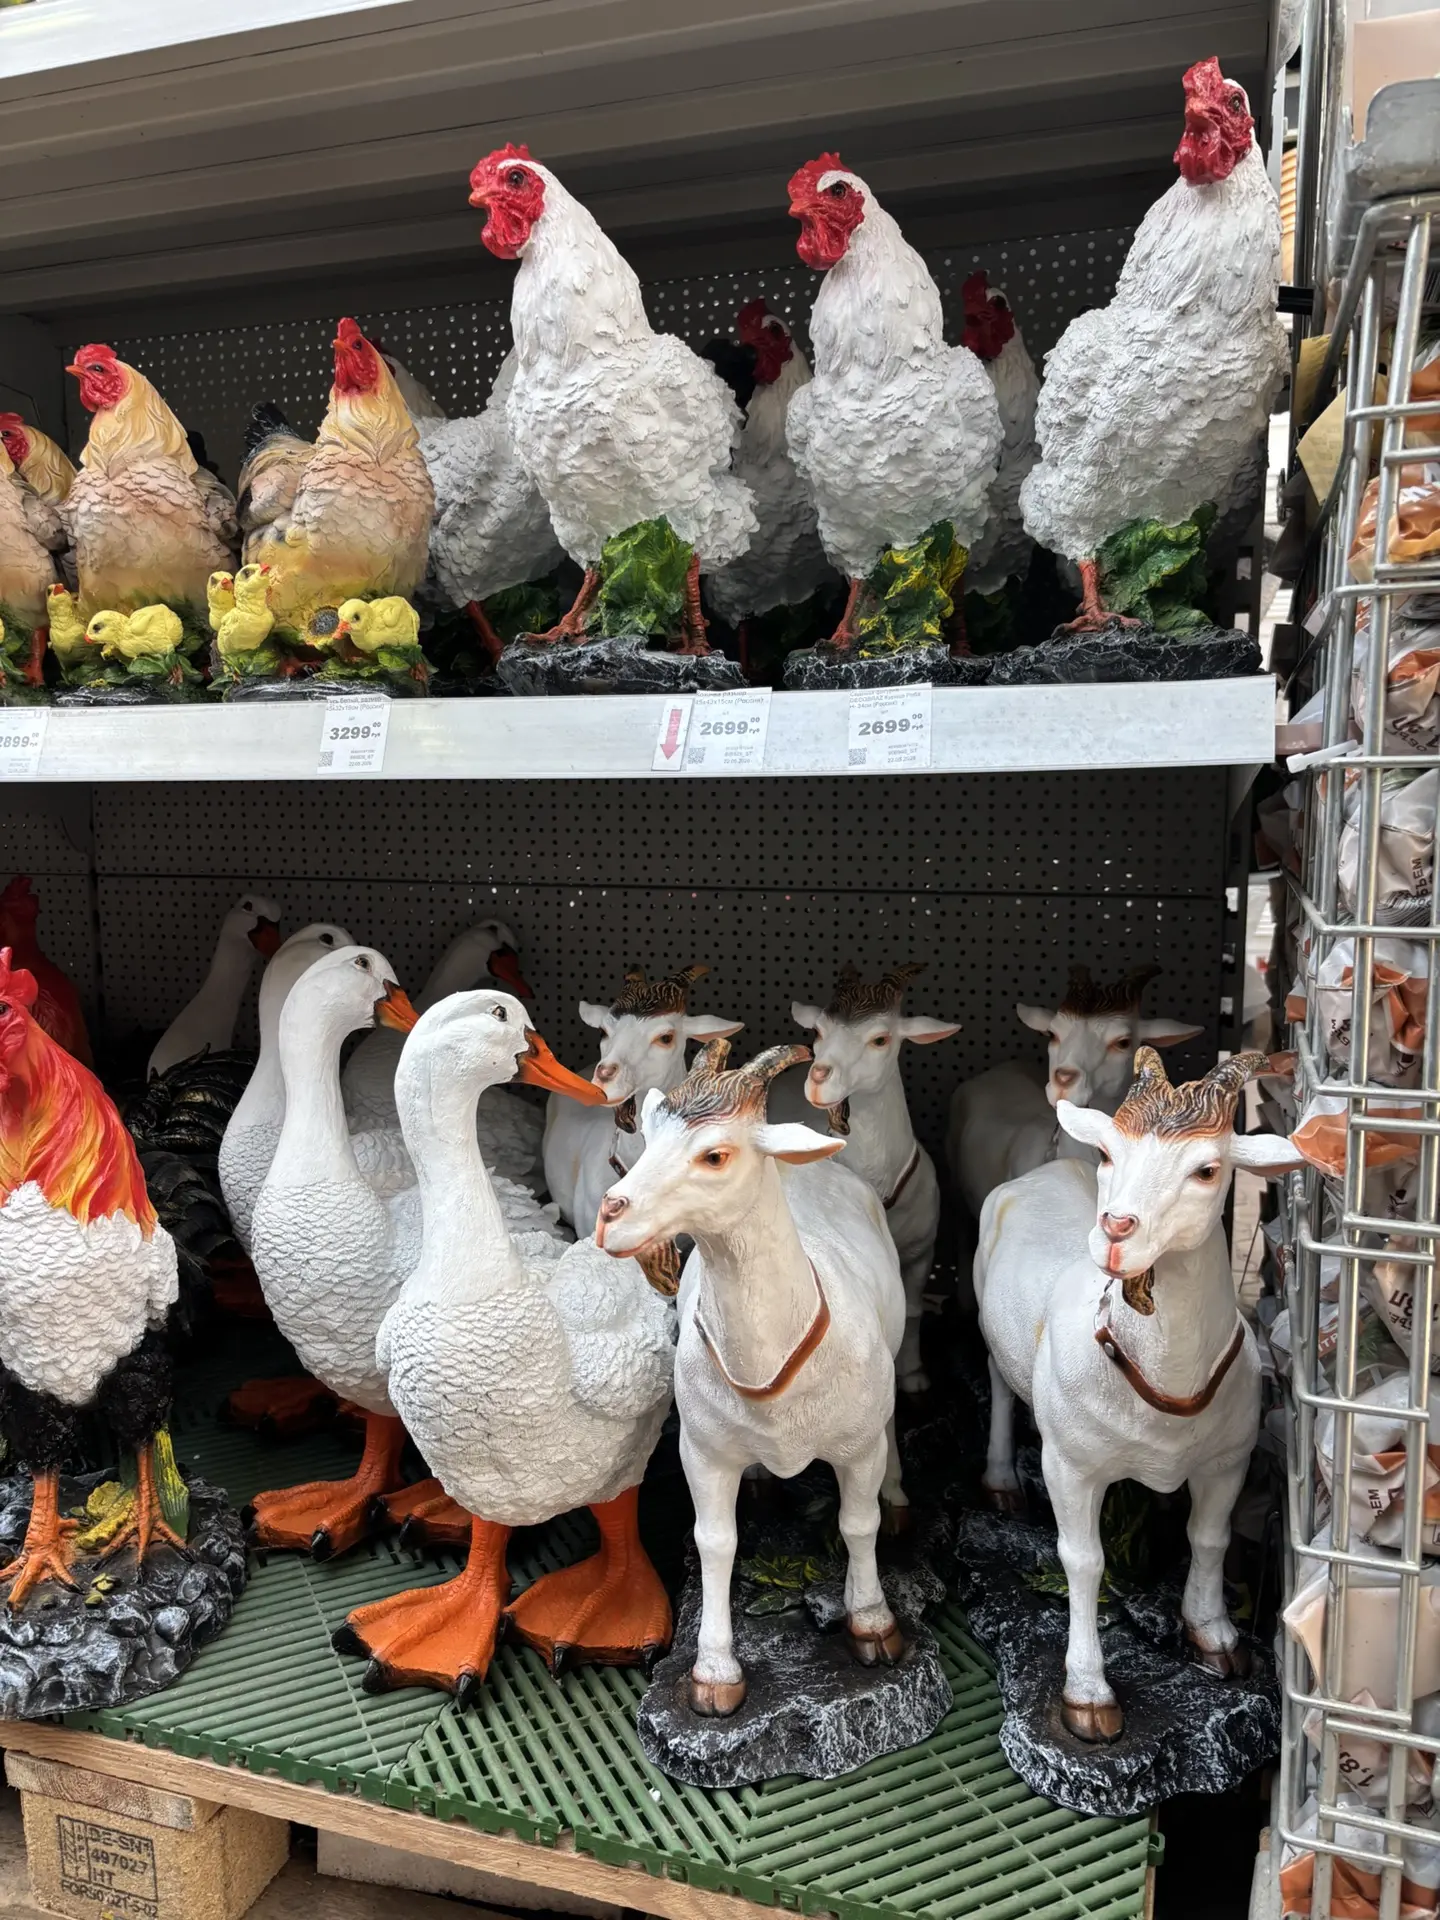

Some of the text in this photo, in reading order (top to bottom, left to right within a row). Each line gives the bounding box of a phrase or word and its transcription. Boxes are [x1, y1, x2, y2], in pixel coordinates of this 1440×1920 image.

[329, 726, 371, 740] 3299
[700, 721, 749, 735] 2699
[858, 718, 911, 736] 2699
[92, 1867, 116, 1886] HT
